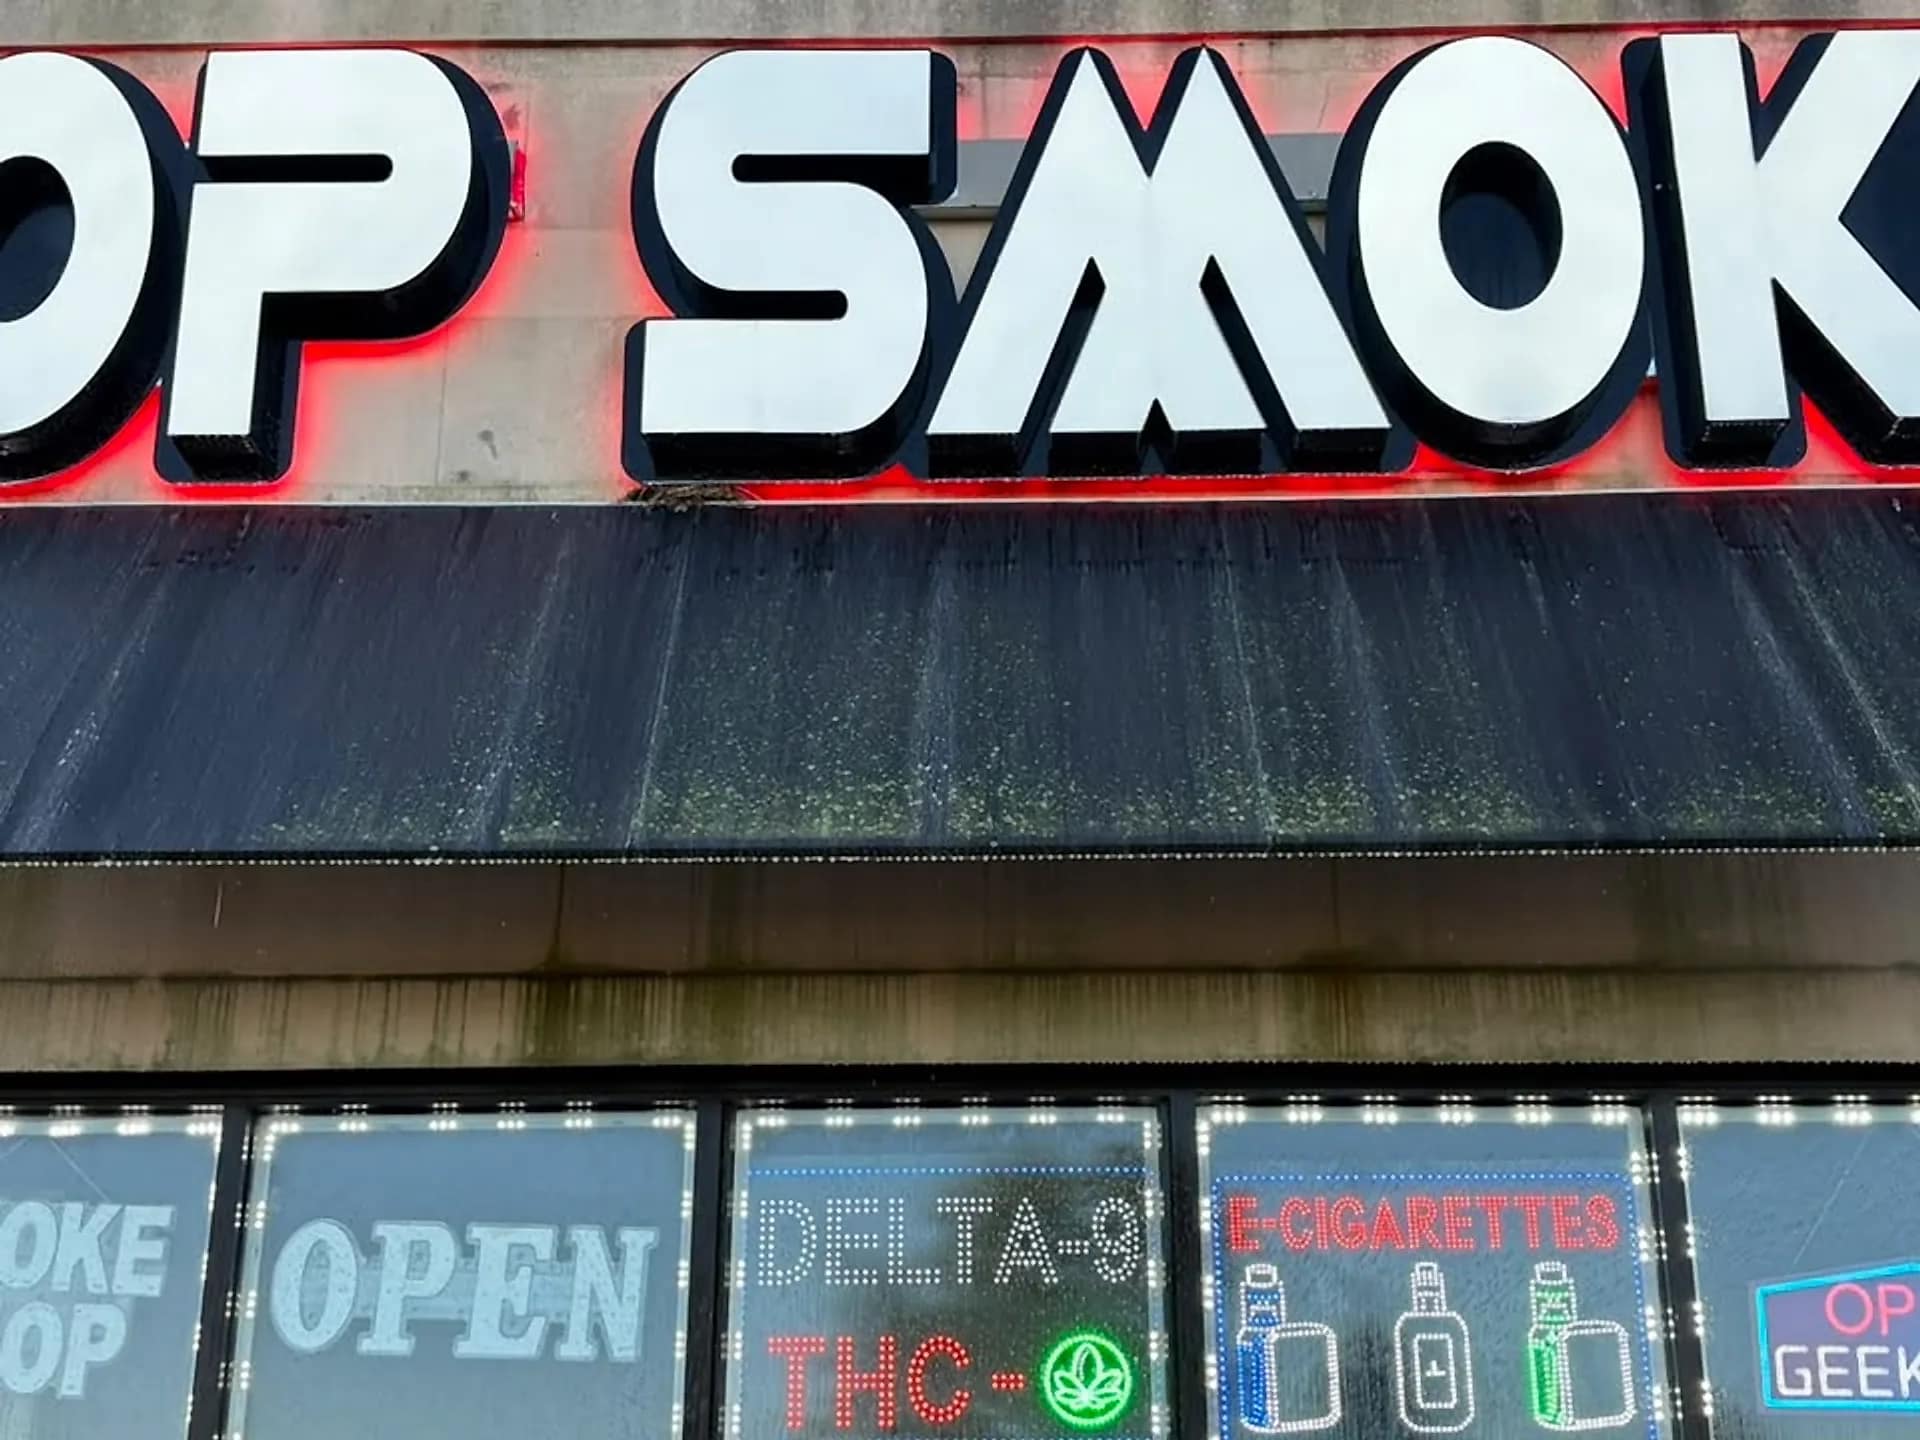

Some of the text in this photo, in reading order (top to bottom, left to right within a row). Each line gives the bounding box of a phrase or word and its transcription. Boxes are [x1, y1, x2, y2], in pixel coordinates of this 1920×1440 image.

[0, 30, 1920, 436] OP SMOK
[0, 1201, 173, 1297] OKE
[757, 1197, 1141, 1286] DELTA-9
[1227, 1194, 1621, 1252] E-CIGARETTES
[271, 1219, 659, 1361] OPEN
[1825, 1283, 1916, 1336] OP
[0, 1301, 128, 1397] OP
[1773, 1345, 1920, 1398] GEEK
